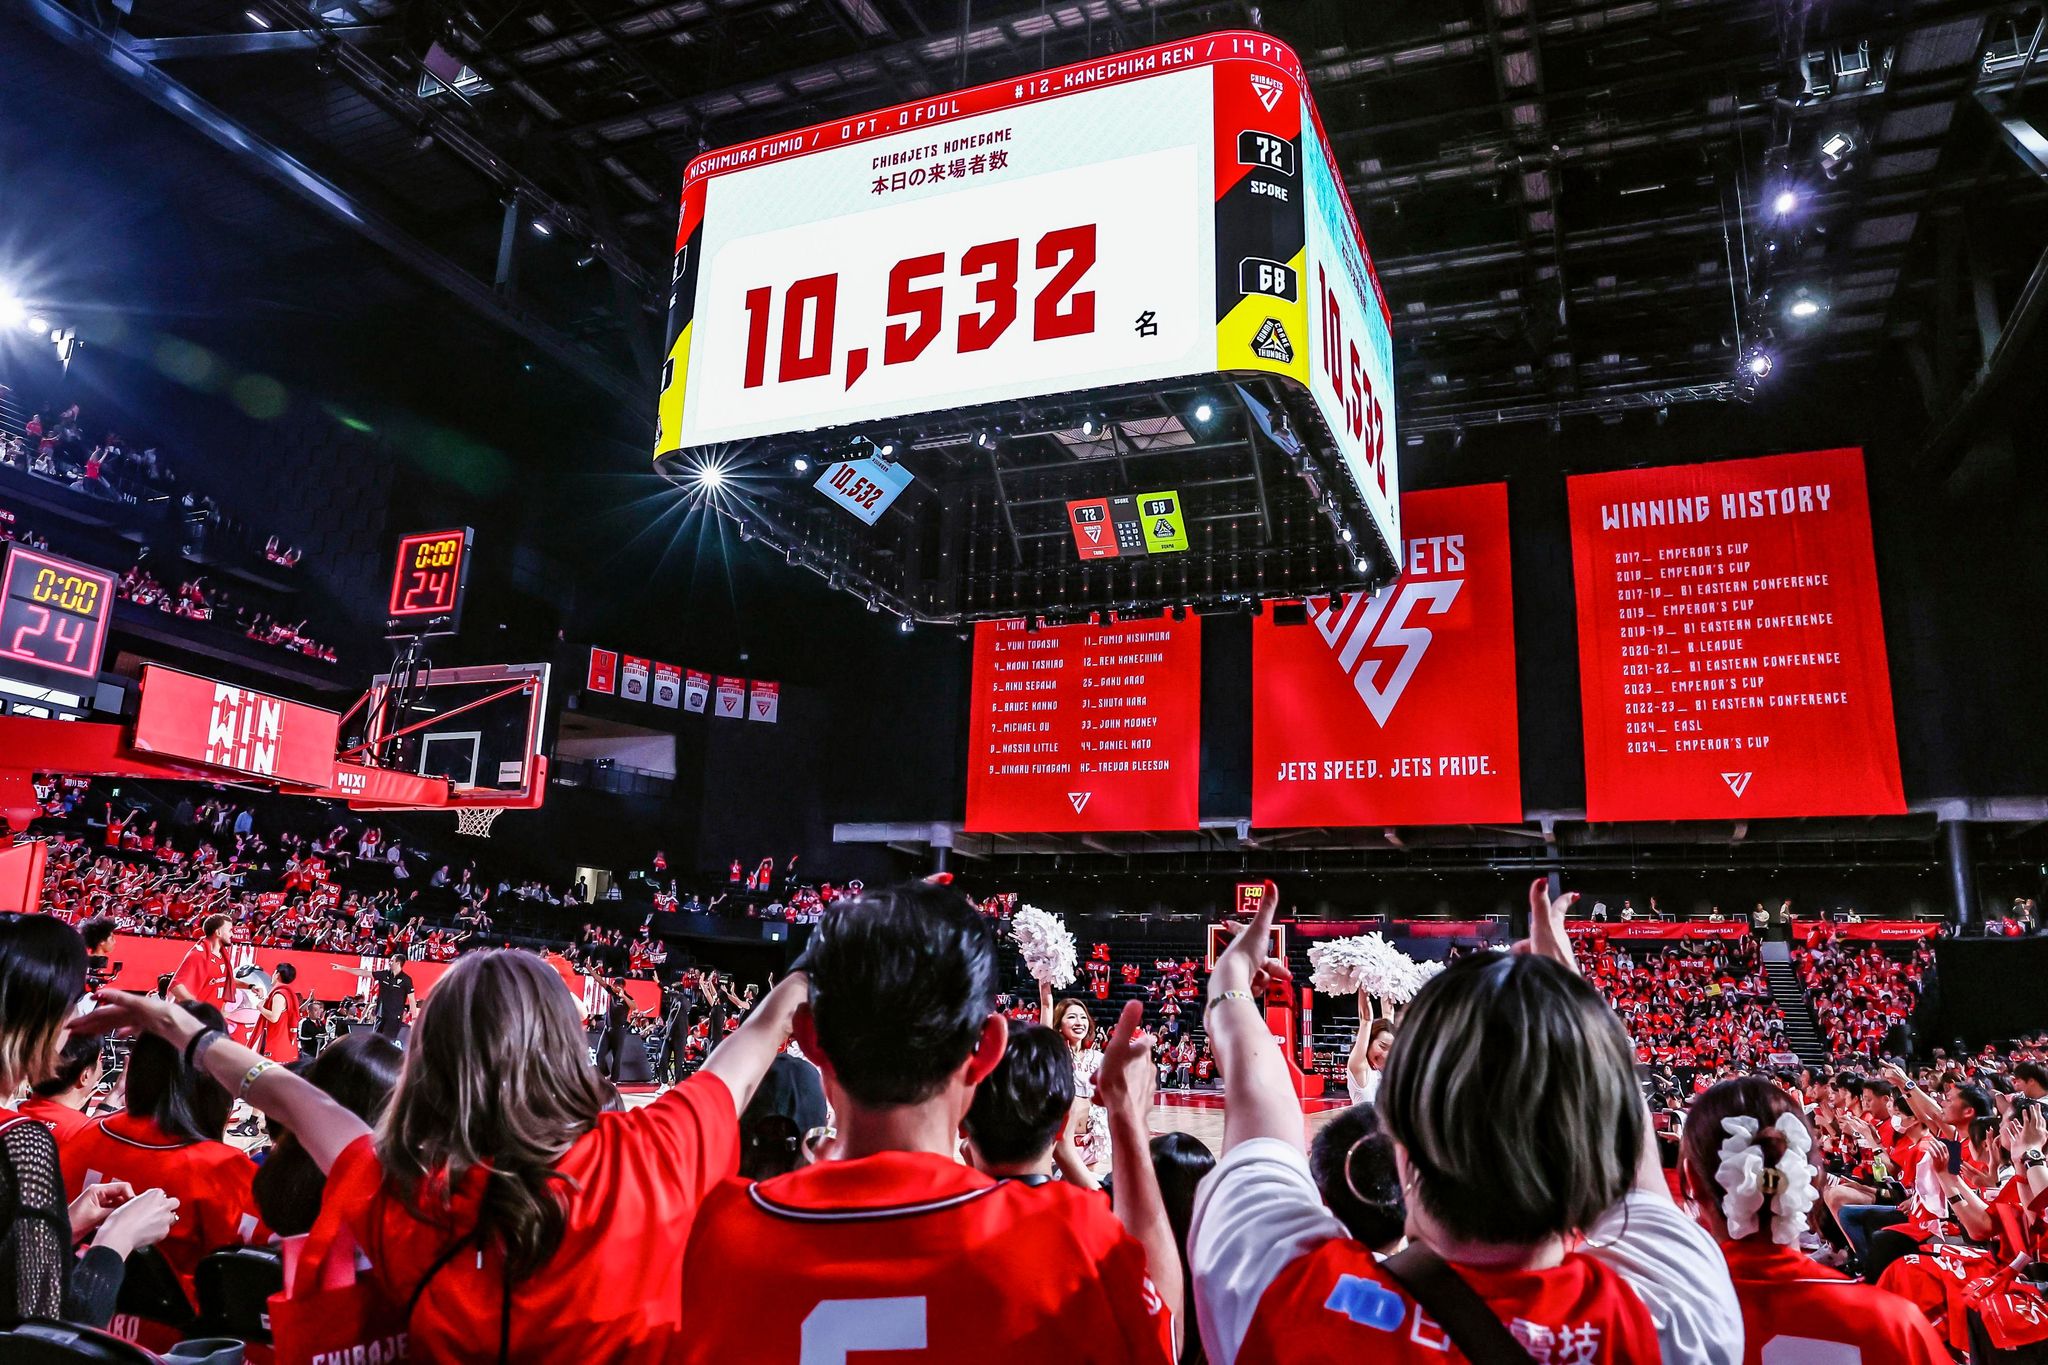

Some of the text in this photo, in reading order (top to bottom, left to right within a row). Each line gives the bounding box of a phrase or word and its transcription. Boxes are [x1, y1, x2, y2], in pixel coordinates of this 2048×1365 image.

[761, 136, 802, 159] FUMIO
[915, 100, 960, 123] FOUL
[1162, 46, 1194, 66] REN
[1232, 39, 1254, 53] 14
[872, 127, 1012, 170] CHIBAJETS HOMEGAME
[1256, 136, 1282, 168] 72
[871, 149, 1009, 195] 本日の来場者数
[1250, 180, 1288, 202] SCORE
[1259, 264, 1286, 295] 68
[744, 223, 1097, 391] 10,532
[1134, 310, 1159, 338] 名
[1318, 259, 1387, 499] 10,532
[829, 463, 884, 510] 10,532
[1082, 508, 1097, 522] 72
[1151, 501, 1166, 515] 68
[1601, 484, 1831, 531] WINNING HISTORY
[415, 540, 457, 569] 0:00
[1401, 534, 1465, 575] ETS
[1658, 545, 1723, 561] EMPEROR'S
[1727, 543, 1749, 555] CUP
[1660, 563, 1724, 579] EMPEROR'S
[1729, 561, 1751, 574] CUP
[33, 568, 98, 614] 0:00
[403, 571, 449, 610] 24
[1697, 580, 1748, 596] EASTERN
[1753, 574, 1829, 591] CONFERENCE
[1662, 601, 1727, 617] EMPEROR'S
[1732, 599, 1755, 611] CUP
[12, 604, 85, 662] 24
[1700, 618, 1751, 634] EASTERN
[1756, 613, 1834, 630] CONFERENCE
[1687, 639, 1743, 653] B.LEAGUE
[1706, 656, 1758, 671] EASTERN
[1763, 652, 1841, 668] CONFERENCE
[1671, 678, 1737, 693] EMPEROR'S
[1742, 676, 1765, 689] CUP
[1712, 695, 1764, 711] EASTERN
[1769, 692, 1848, 707] CONFERENCE
[1674, 719, 1703, 732] EASL
[1033, 742, 1059, 753] LITTLE
[1675, 736, 1742, 752] EMPEROR'S
[1747, 735, 1770, 748] CUP
[1278, 755, 1497, 782] JETS SPEED. JETS PRIDE.
[338, 772, 366, 789] MIXI
[1243, 897, 1260, 912] 24
